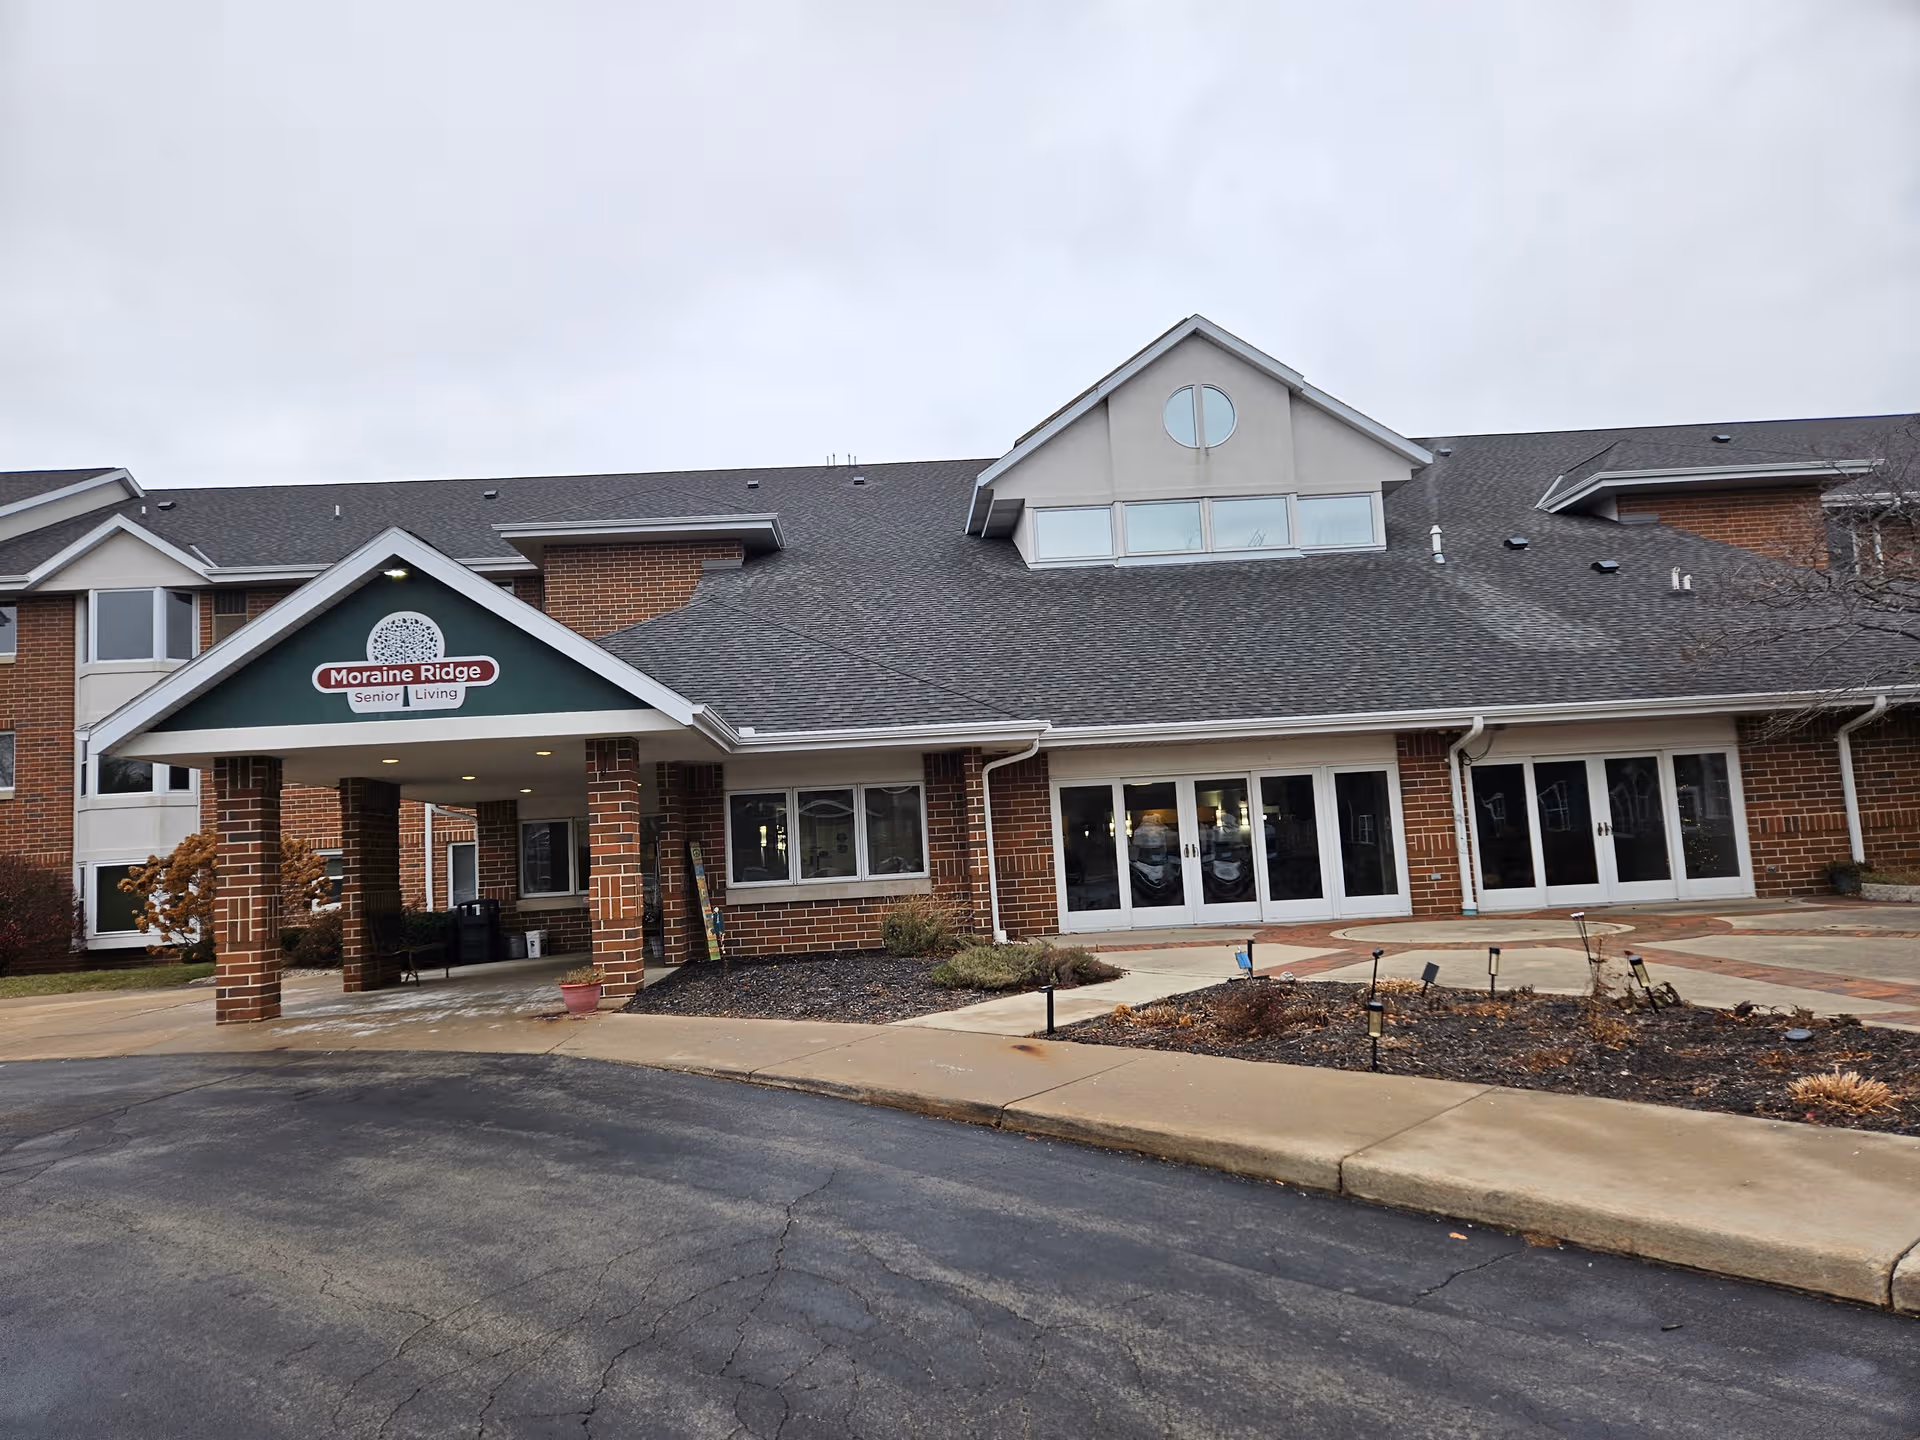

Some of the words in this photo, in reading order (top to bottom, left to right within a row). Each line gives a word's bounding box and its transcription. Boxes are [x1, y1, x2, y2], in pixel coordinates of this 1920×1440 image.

[330, 667, 414, 685] Moraine
[420, 664, 481, 682] Ridge
[354, 691, 400, 703] Senior
[415, 688, 458, 700] Living
